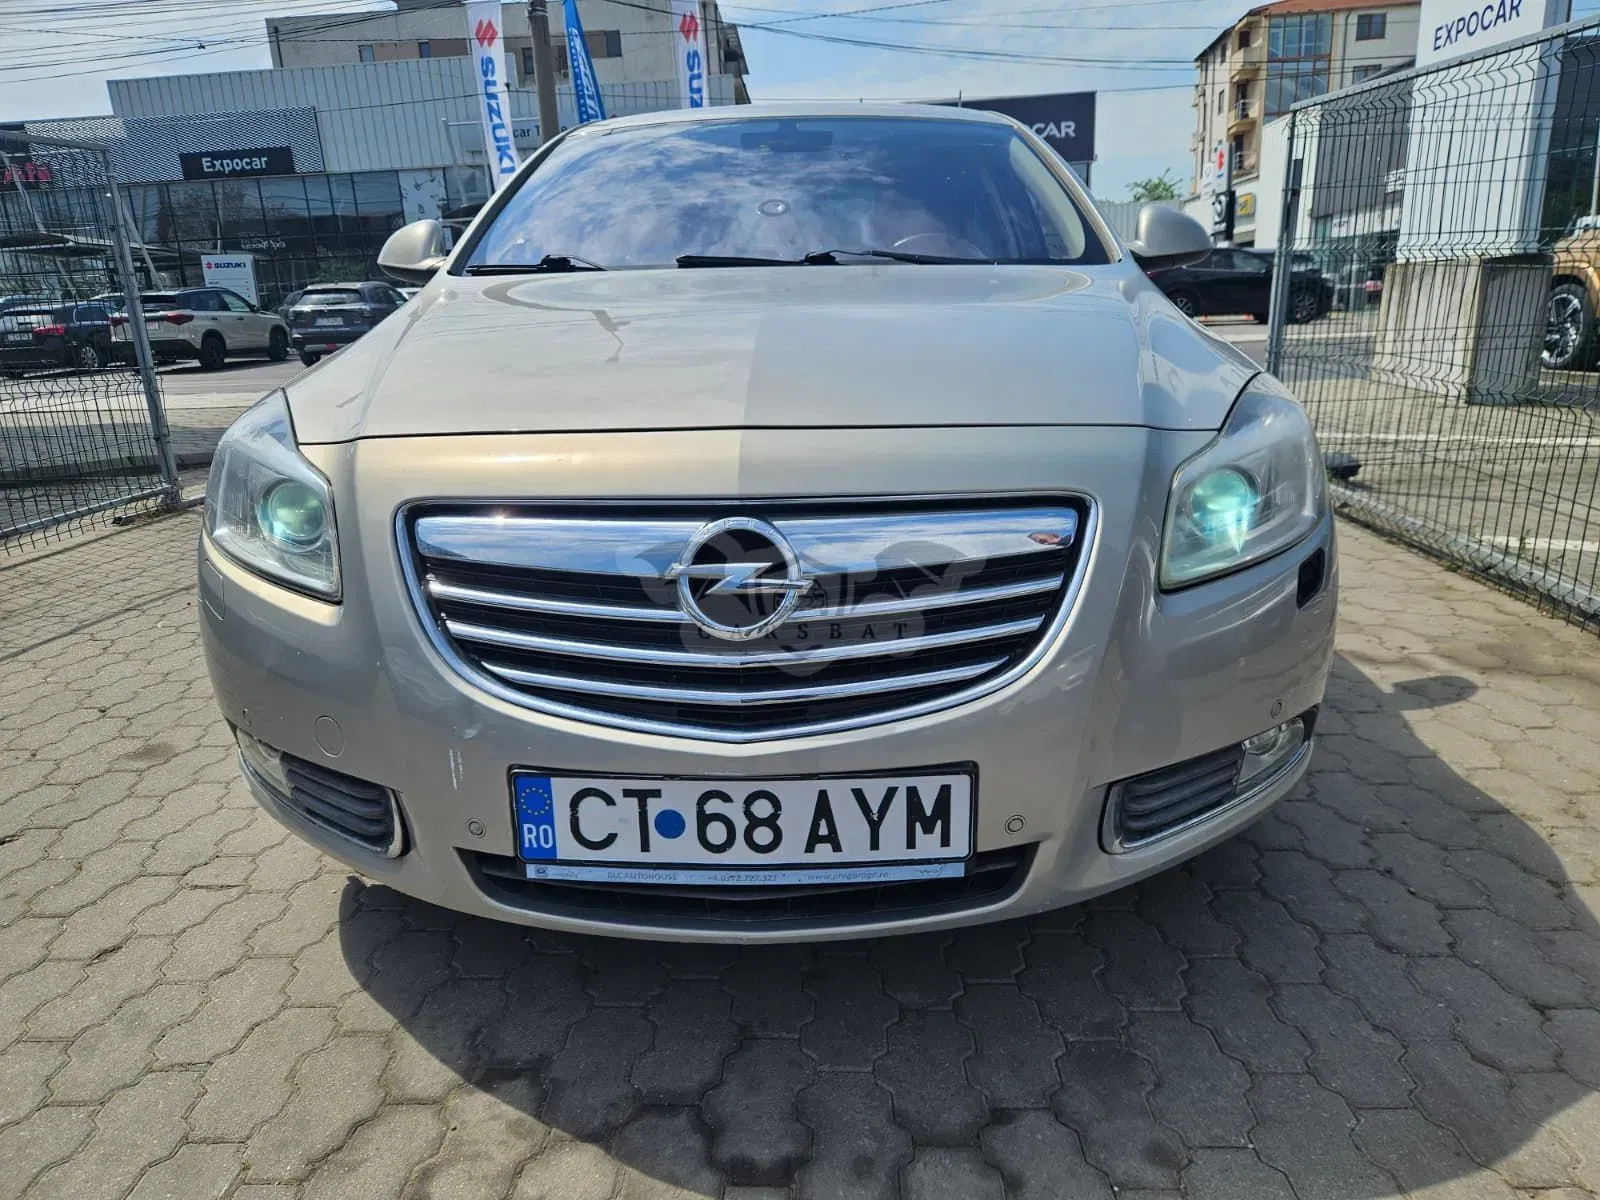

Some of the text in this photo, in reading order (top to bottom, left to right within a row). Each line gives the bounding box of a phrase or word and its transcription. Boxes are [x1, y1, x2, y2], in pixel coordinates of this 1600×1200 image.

[1433, 0, 1523, 51] EXPOCAR
[687, 49, 703, 109] SUZ
[480, 56, 516, 174] SUZUKI
[513, 127, 530, 138] car
[1031, 121, 1076, 139] CAR
[201, 157, 268, 174] Expocar
[214, 262, 247, 270] SUZUKI
[569, 783, 953, 854] CT 68 AYM
[523, 823, 554, 849] RO
